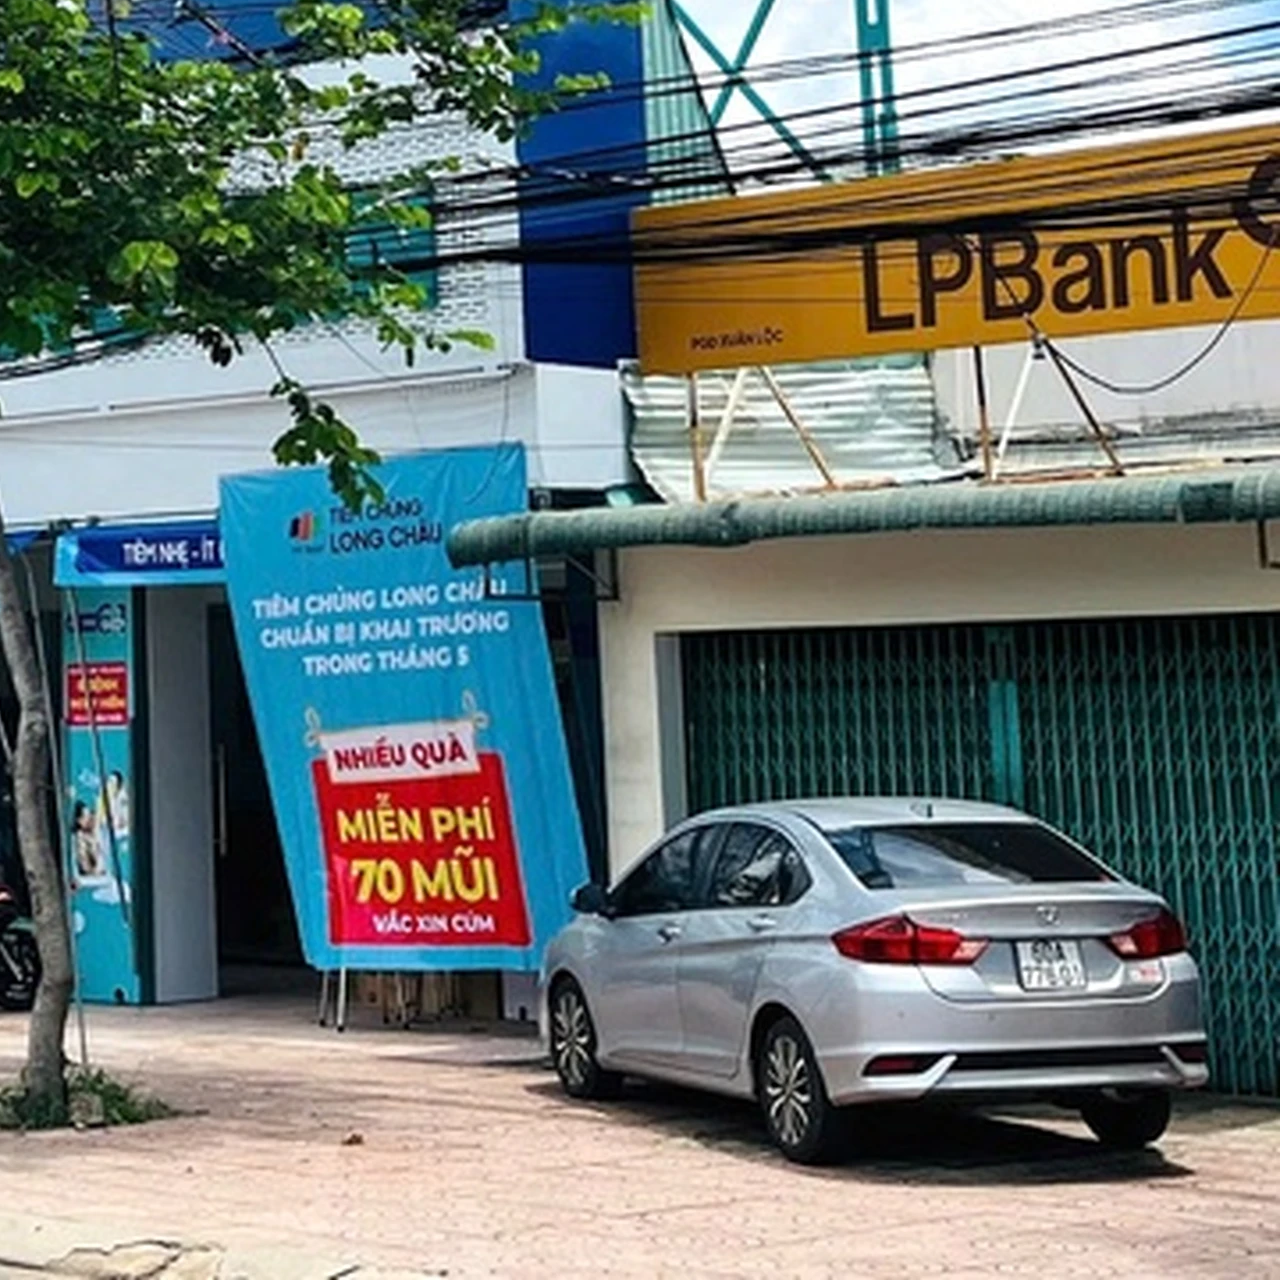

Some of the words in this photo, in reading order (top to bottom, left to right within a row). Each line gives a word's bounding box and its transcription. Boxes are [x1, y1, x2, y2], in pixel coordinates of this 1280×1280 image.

[864, 206, 1233, 333] LPBank
[330, 528, 384, 555] LONG
[252, 591, 300, 619] TIÊM
[380, 584, 440, 610] LONG
[334, 621, 355, 648] BỊ
[359, 618, 412, 643] KHAI
[416, 609, 510, 638] TRƯƠNG
[302, 650, 374, 677] TRONG
[376, 642, 453, 671] THÁNG
[410, 732, 468, 770] QUÀ
[336, 792, 424, 844] MIỄN
[429, 795, 496, 842] PHÍ
[350, 857, 405, 904] 70
[410, 845, 500, 904] MŨI
[372, 908, 413, 934] VẮC
[415, 912, 449, 933] XIN
[451, 910, 496, 933] CÚM
